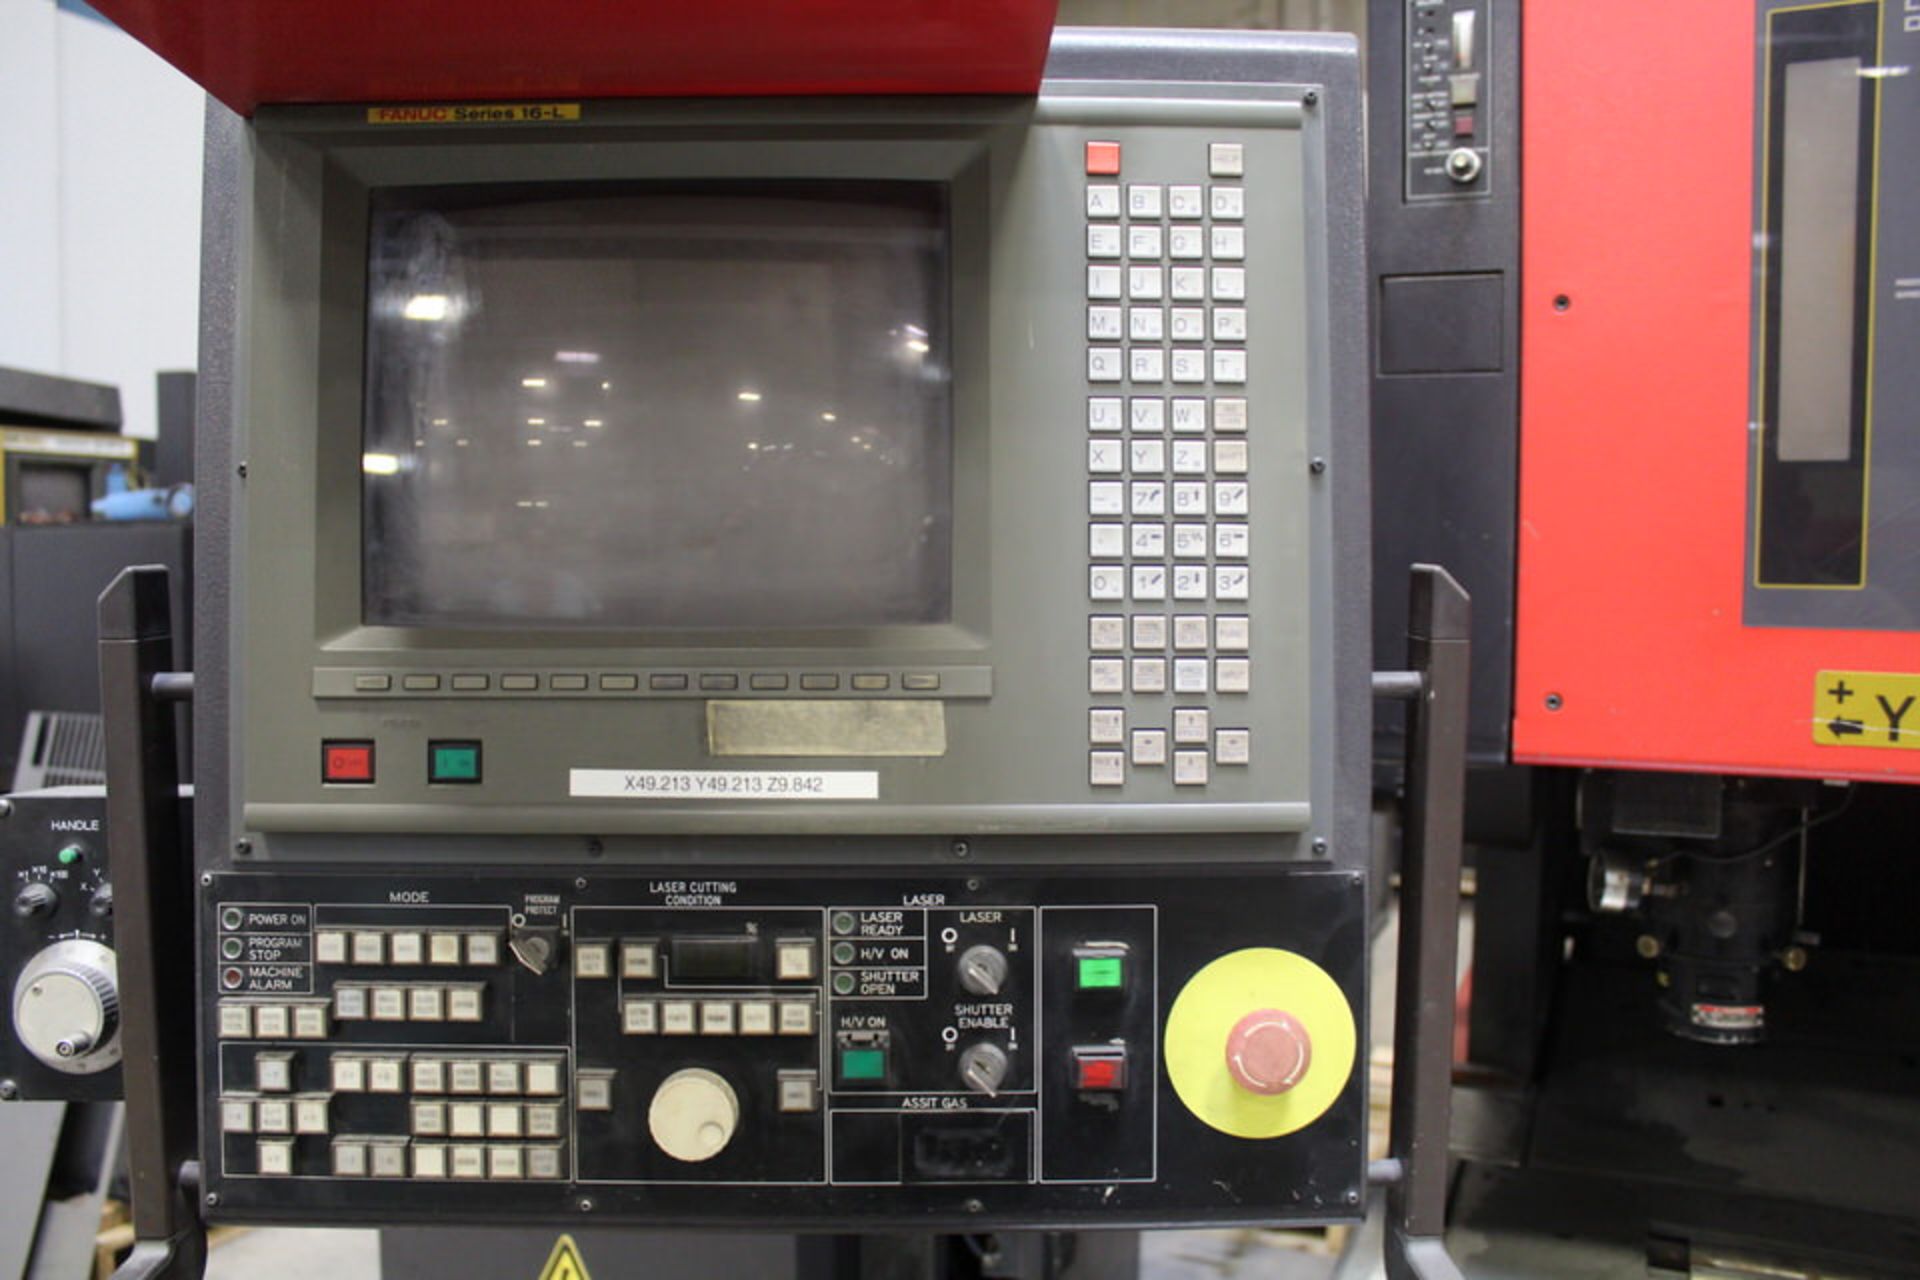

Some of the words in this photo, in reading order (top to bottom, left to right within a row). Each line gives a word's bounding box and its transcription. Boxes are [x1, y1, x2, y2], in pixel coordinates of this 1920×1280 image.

[379, 107, 448, 122] FANUC
[453, 105, 515, 121] Series
[521, 104, 565, 120] 16-L
[1090, 193, 1103, 207] A
[1132, 194, 1145, 209] B
[1173, 195, 1185, 210] C
[1215, 196, 1227, 211] D
[1091, 234, 1103, 249] E
[1215, 235, 1227, 248] H
[1133, 275, 1144, 290] J
[1175, 276, 1186, 291] K
[1091, 316, 1105, 331] M
[1133, 317, 1146, 331] N
[1135, 357, 1148, 372] R
[1175, 358, 1188, 373] S
[1216, 359, 1230, 374] T
[1134, 408, 1148, 423] V
[1176, 408, 1190, 423] W
[1092, 450, 1105, 463] X
[1134, 450, 1147, 464] Y
[1176, 450, 1188, 464] Z
[1136, 533, 1148, 547] 4
[1177, 575, 1190, 591] 2
[1218, 576, 1231, 590] 3
[1876, 695, 1917, 742] Y
[623, 774, 691, 791] X49.213
[697, 775, 763, 792] Y49.213
[767, 776, 824, 793] Z9.842
[51, 819, 100, 831] HANDLE
[649, 881, 687, 894] LASER
[689, 881, 737, 894] CUTTING
[389, 891, 430, 903] MODE
[665, 895, 722, 906] CONDITION
[903, 894, 945, 906] LASER
[249, 913, 288, 926] POWER
[290, 914, 307, 925] ON
[861, 911, 903, 923] LASER
[959, 911, 1003, 923] LASER
[861, 924, 904, 936] READY
[249, 937, 303, 949] PROGRAM
[249, 949, 281, 961] STOP
[860, 948, 885, 960] H/V
[890, 948, 909, 960] ON
[249, 966, 303, 979] MACHINE
[861, 971, 920, 983] SHUTTER
[249, 979, 293, 991] ALARM
[861, 983, 896, 995] OPEN
[954, 1003, 1013, 1015] SHUTTER
[841, 1016, 865, 1028] H/V
[867, 1016, 886, 1027] ON
[958, 1016, 1010, 1029] ENABLE
[902, 1097, 937, 1109] ASSIT
[941, 1097, 968, 1109] GAS
